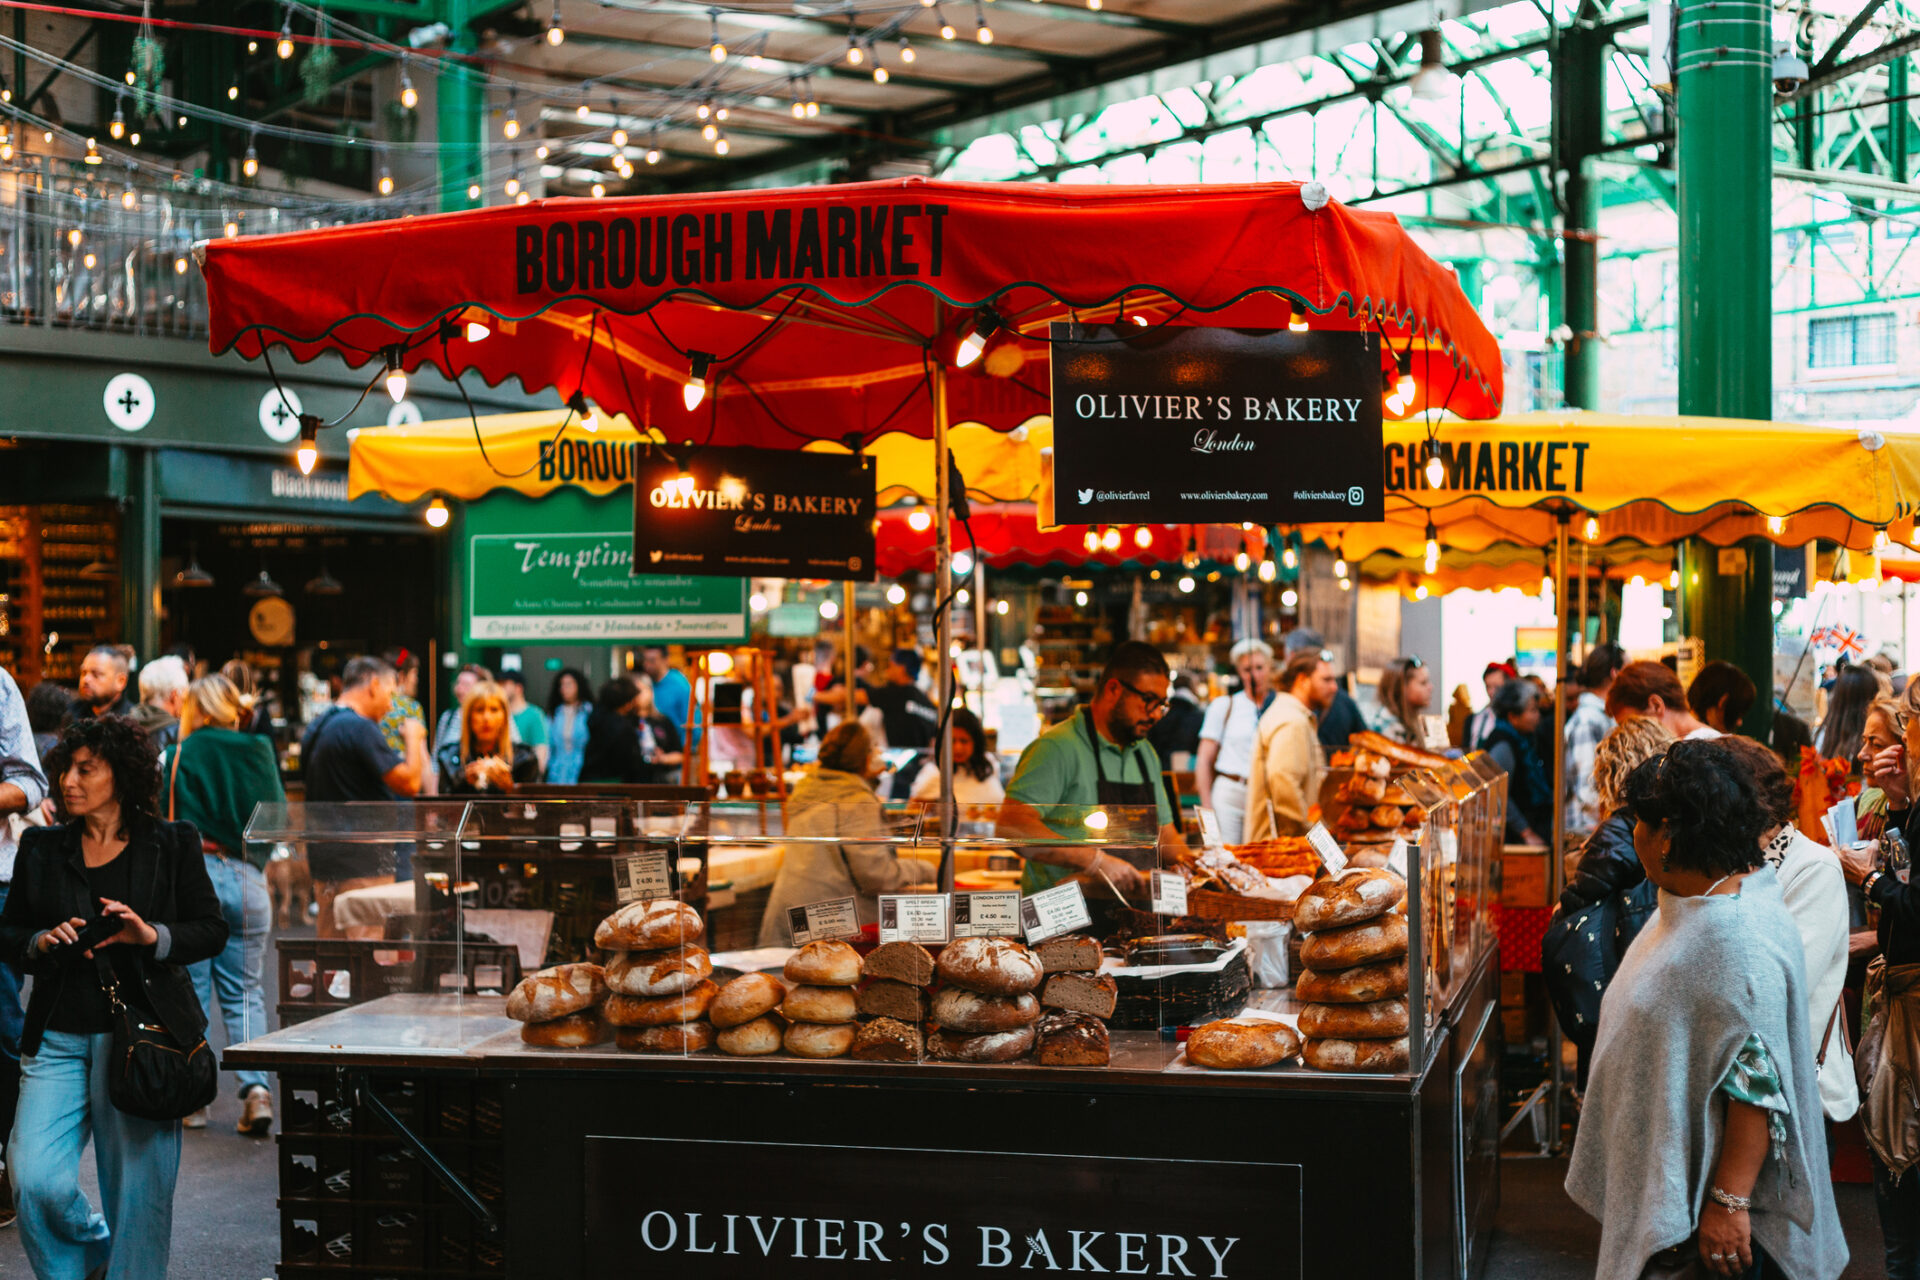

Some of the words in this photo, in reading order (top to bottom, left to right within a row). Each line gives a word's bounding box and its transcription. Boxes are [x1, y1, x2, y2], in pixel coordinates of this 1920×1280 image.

[516, 212, 733, 295] BOROUGH
[745, 205, 949, 280] MARKET
[1075, 394, 1232, 421] OLIVIER'S
[1243, 396, 1363, 422] BAKERY
[1190, 428, 1256, 454] London
[1440, 441, 1590, 492] MARKET
[773, 494, 862, 515] BAKERY
[1096, 490, 1150, 502] @olivierfavrel
[1180, 490, 1268, 502] www.oliviersbakery.com
[1293, 490, 1346, 502] #oliviersbakery
[640, 1210, 950, 1265] OLIVIER'S
[977, 1225, 1240, 1279] BAKERY
